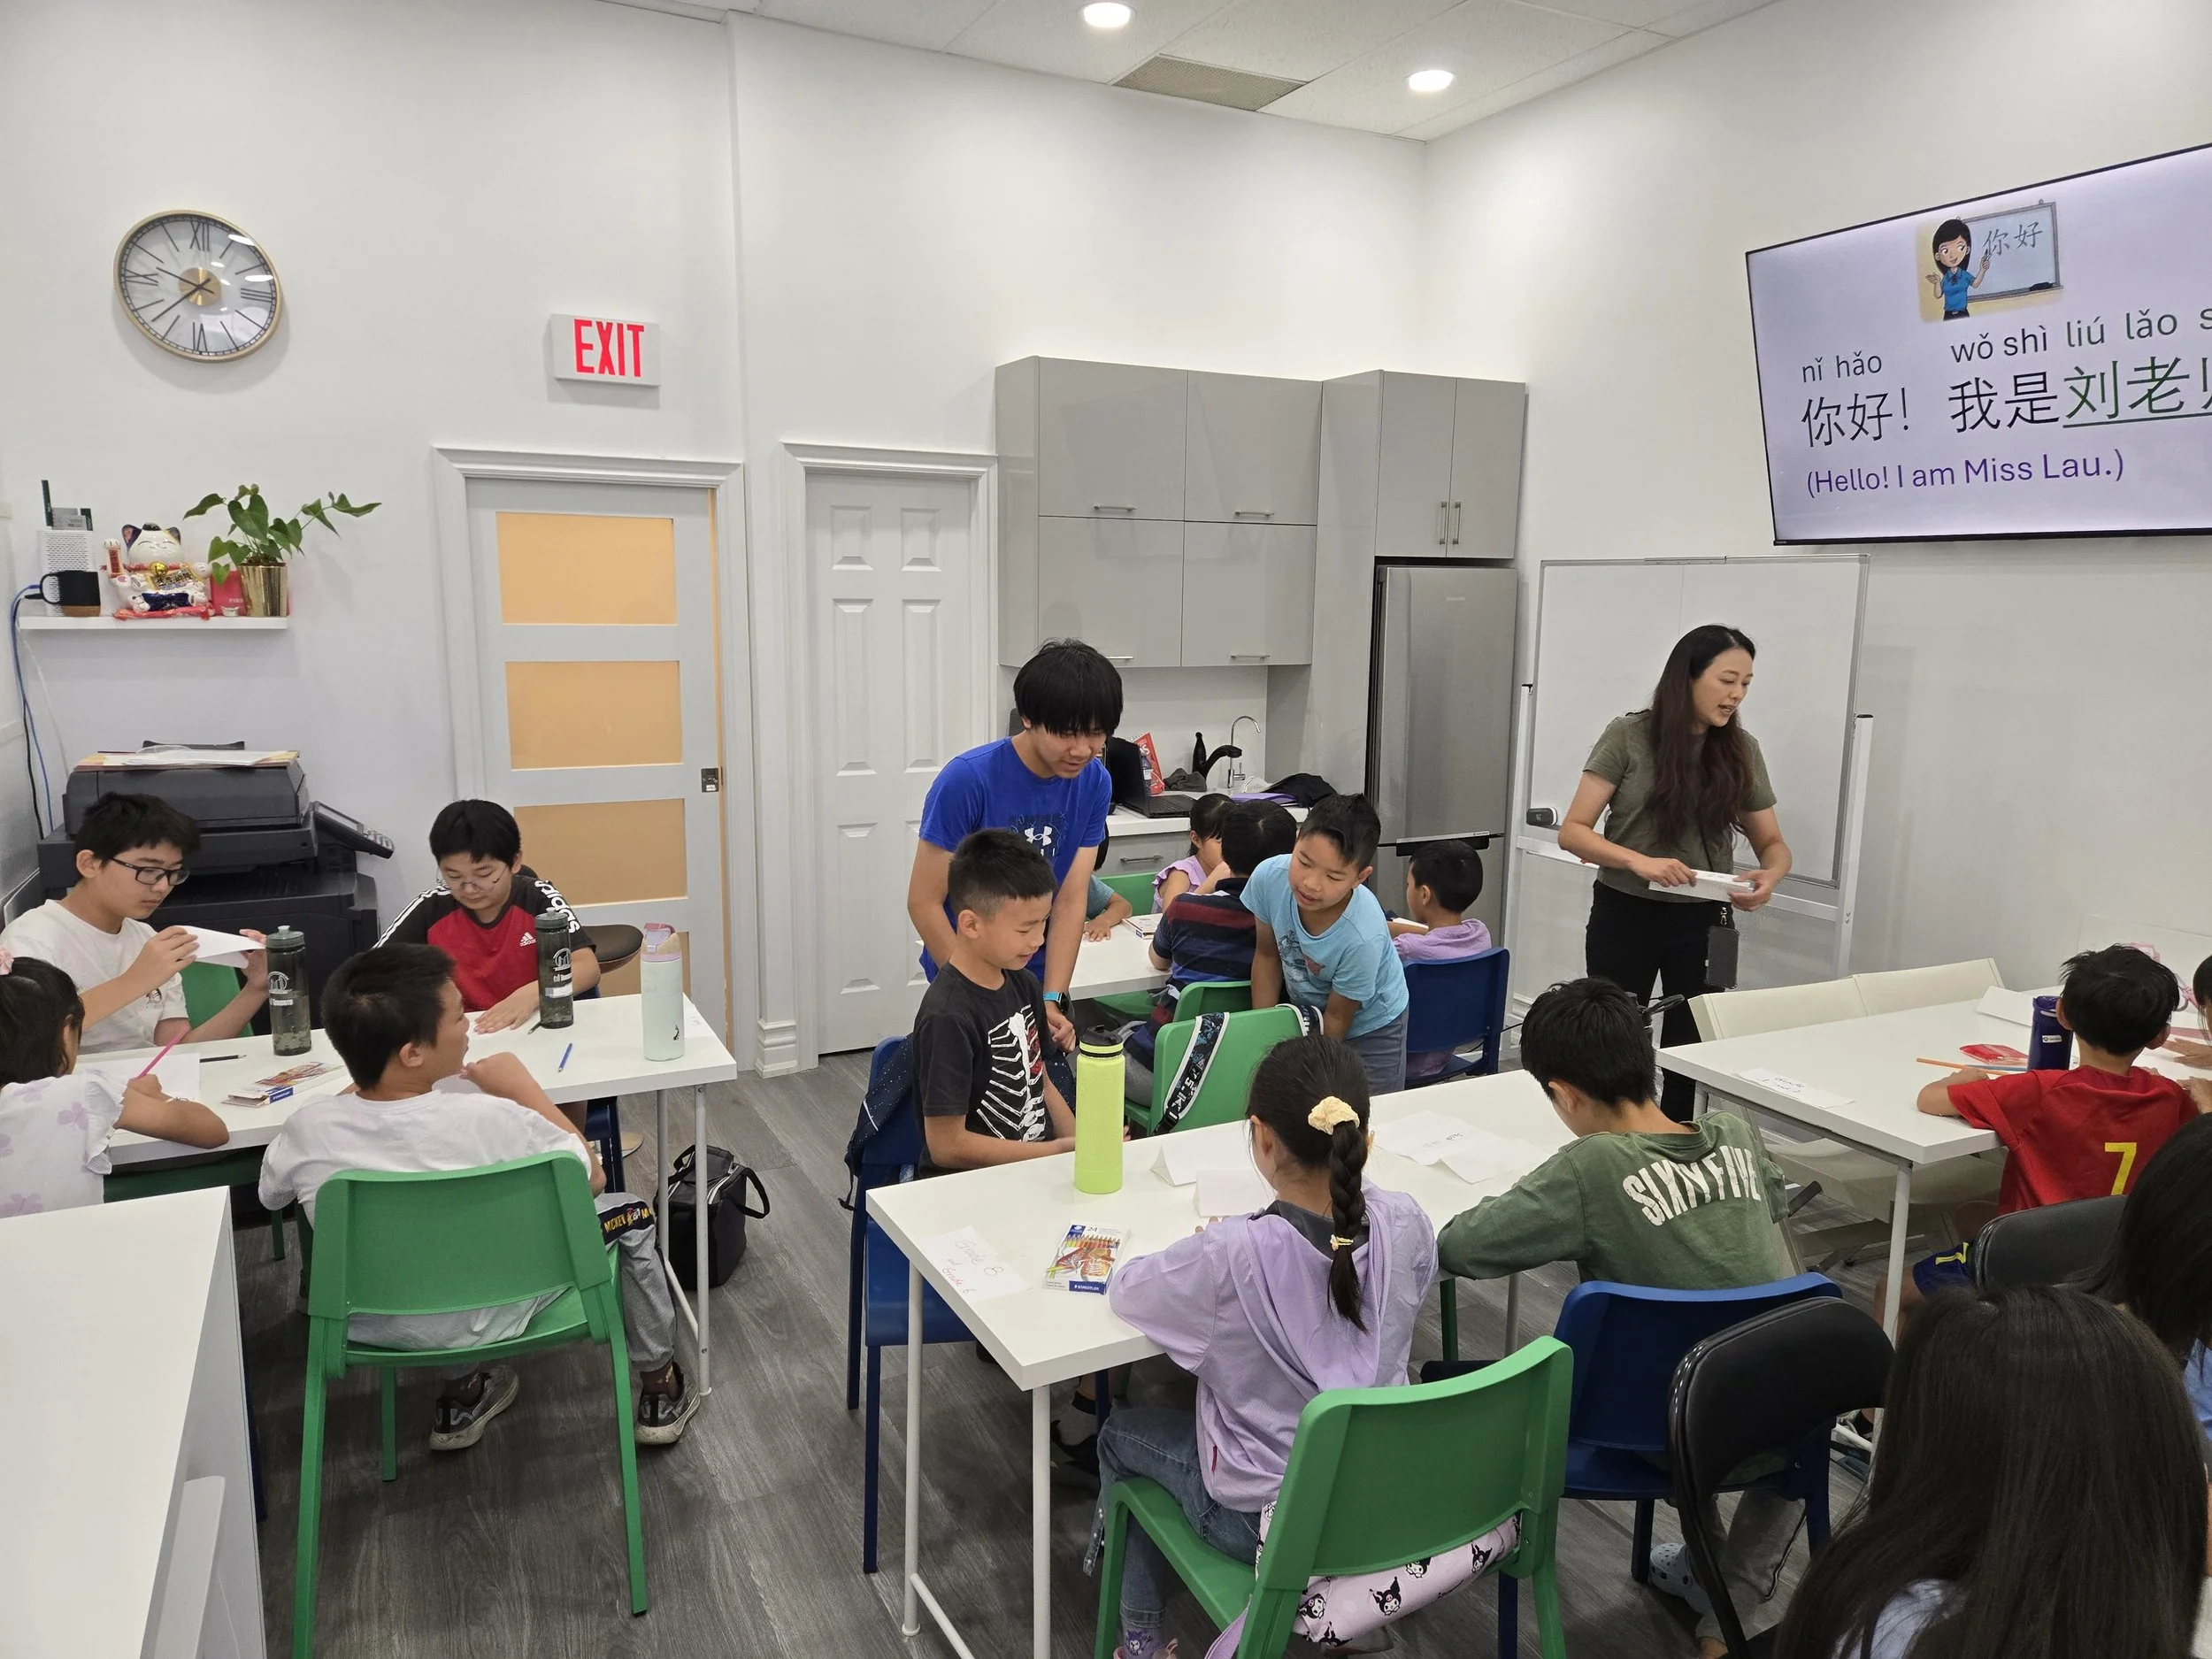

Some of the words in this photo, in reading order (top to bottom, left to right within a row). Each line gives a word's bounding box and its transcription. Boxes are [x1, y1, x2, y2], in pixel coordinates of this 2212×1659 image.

[1983, 221, 2043, 256] 你好
[573, 318, 645, 378] EXIT
[1801, 356, 1824, 383] nǐ
[1836, 349, 1882, 379] hǎo
[1950, 332, 1993, 364] wǒ
[2003, 325, 2047, 357] shì
[2067, 316, 2106, 348] liú
[2125, 308, 2178, 340] lǎo
[1807, 465, 1889, 499] (Hello!
[1897, 465, 1903, 488] I
[1912, 466, 1955, 488] am
[1964, 457, 2033, 484] Miss
[2042, 448, 2124, 482] Lau.)
[2105, 1142, 2137, 1195] 7
